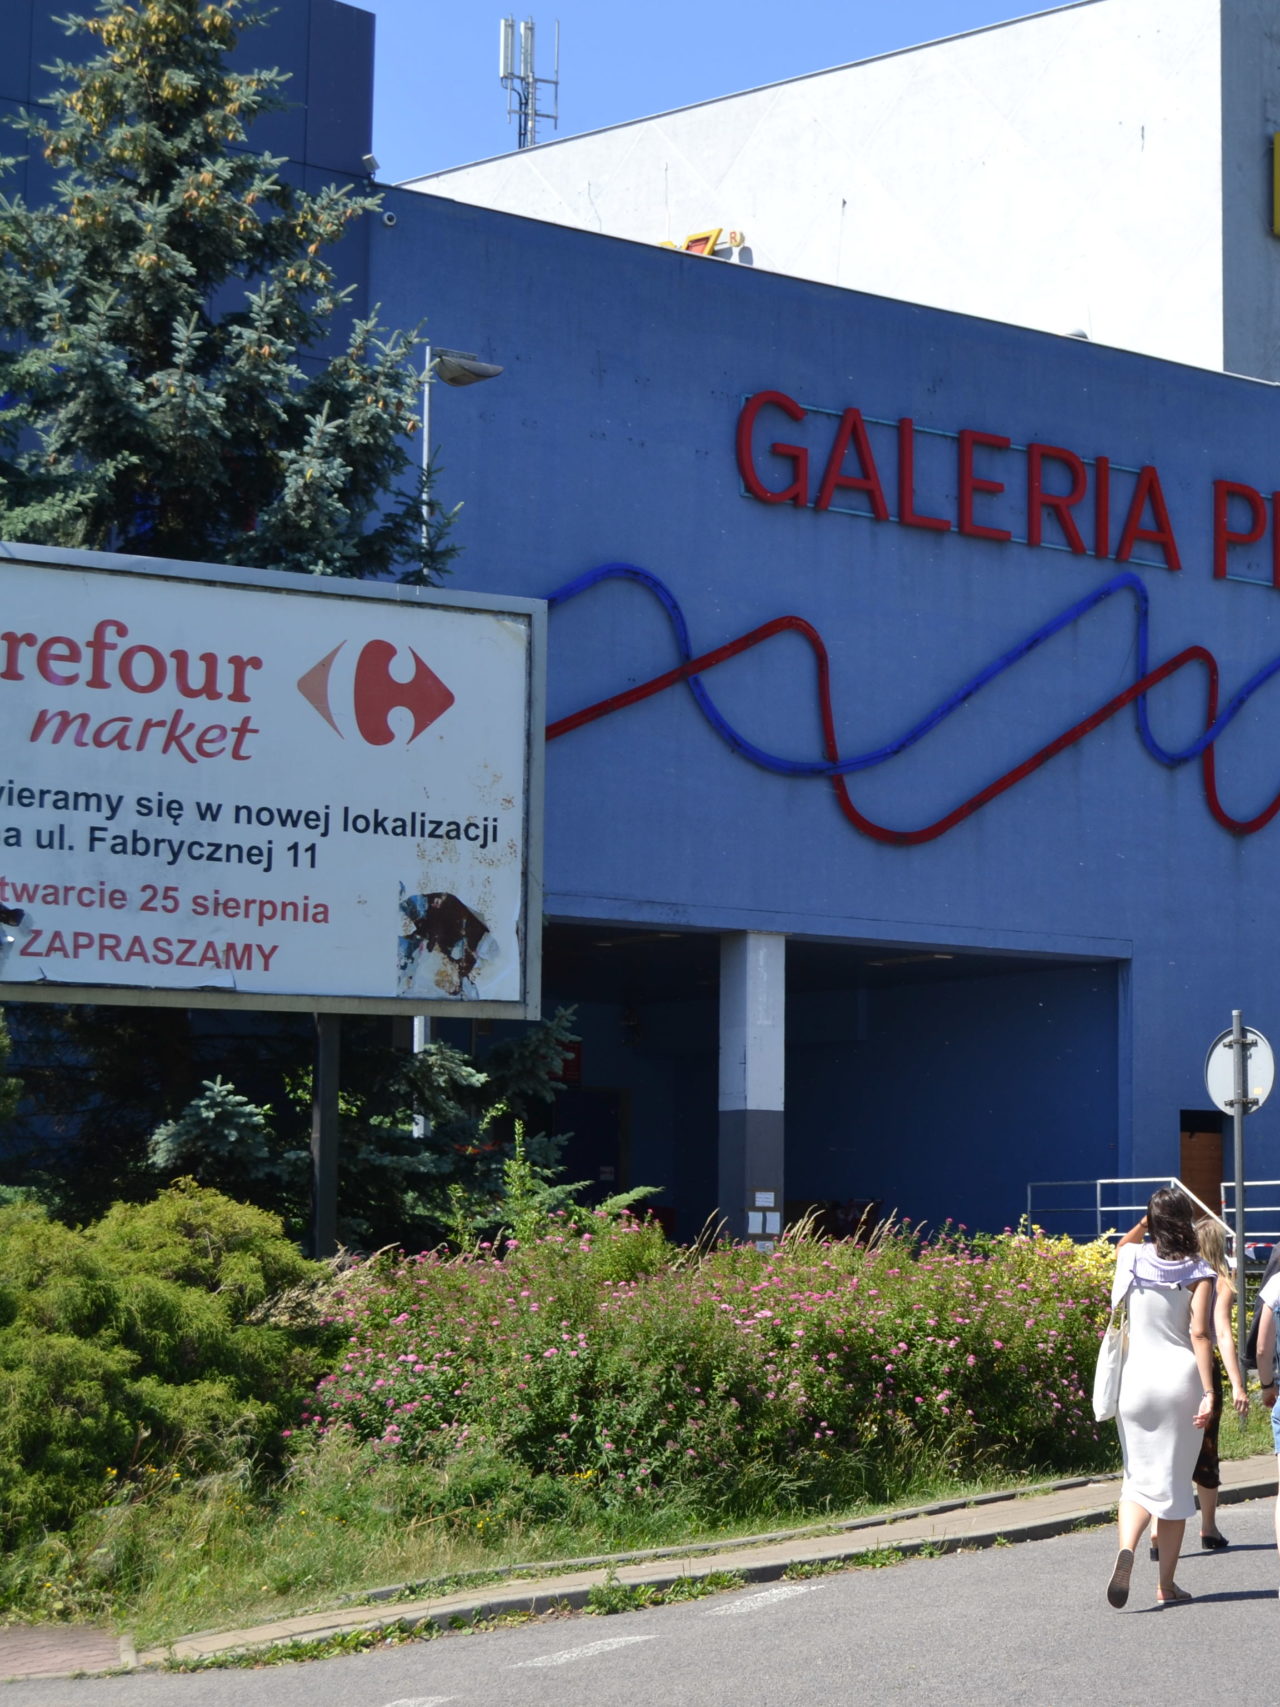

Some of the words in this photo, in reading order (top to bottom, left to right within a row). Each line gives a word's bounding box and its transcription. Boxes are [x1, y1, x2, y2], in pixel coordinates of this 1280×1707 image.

[738, 391, 1181, 570] GALERIA
[29, 707, 261, 764] market
[0, 780, 124, 821] ieramy
[135, 791, 185, 827] się
[195, 801, 223, 823] w
[233, 804, 331, 838] nowej
[342, 806, 499, 849] lokalizacji
[35, 823, 74, 851] ul.
[88, 825, 274, 873] Fabrycznej
[286, 841, 317, 869] 11
[139, 883, 180, 914] 25
[191, 889, 330, 927] sierpnia
[19, 928, 280, 973] ZAPRASZAMY
